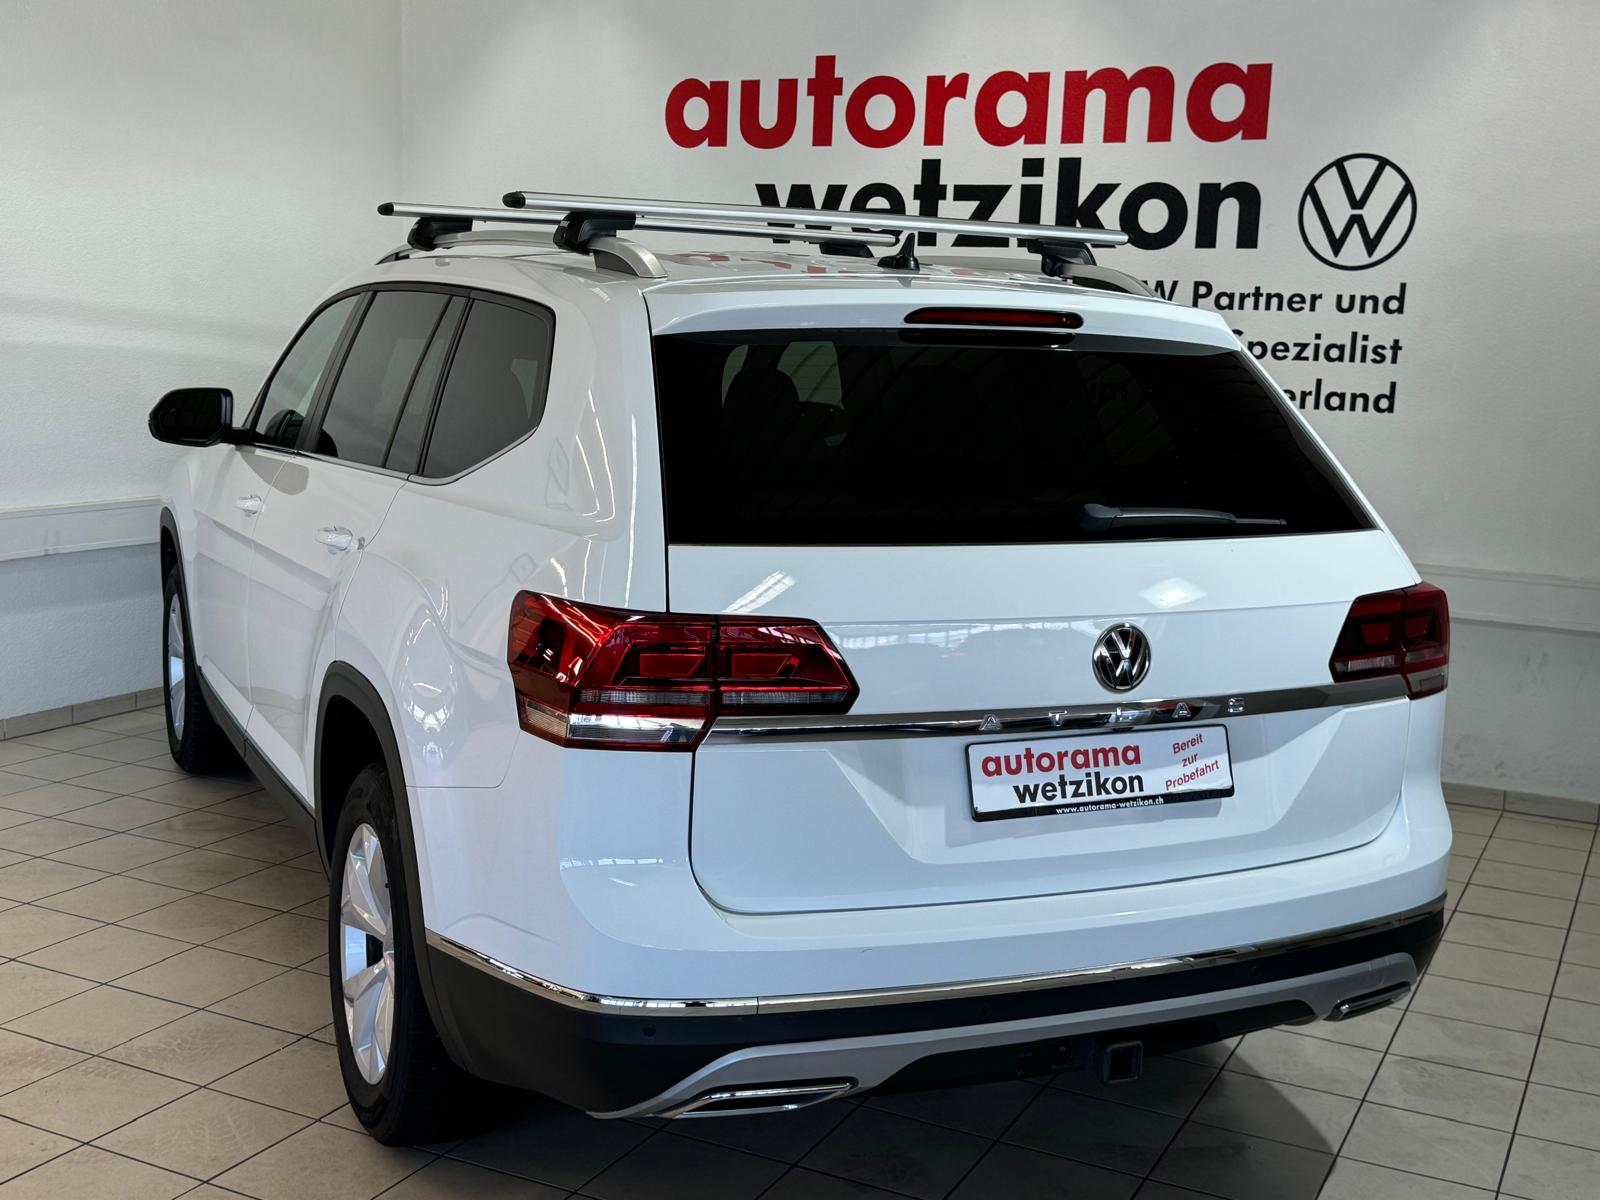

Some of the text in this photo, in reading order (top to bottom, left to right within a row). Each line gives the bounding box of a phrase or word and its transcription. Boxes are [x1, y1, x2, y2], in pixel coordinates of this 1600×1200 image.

[665, 55, 1273, 149] autorama
[1141, 280, 1407, 315] W Partner und
[1283, 378, 1397, 414] erland
[979, 698, 1245, 731] ATLAS
[981, 743, 1141, 777] autorama
[1172, 733, 1204, 755] Bereit
[1181, 753, 1198, 767] zur
[1013, 771, 1144, 804] wetzikon
[1165, 760, 1220, 791] Probefahrt
[1056, 796, 1164, 814] www.autorama-wetzikon.ch
